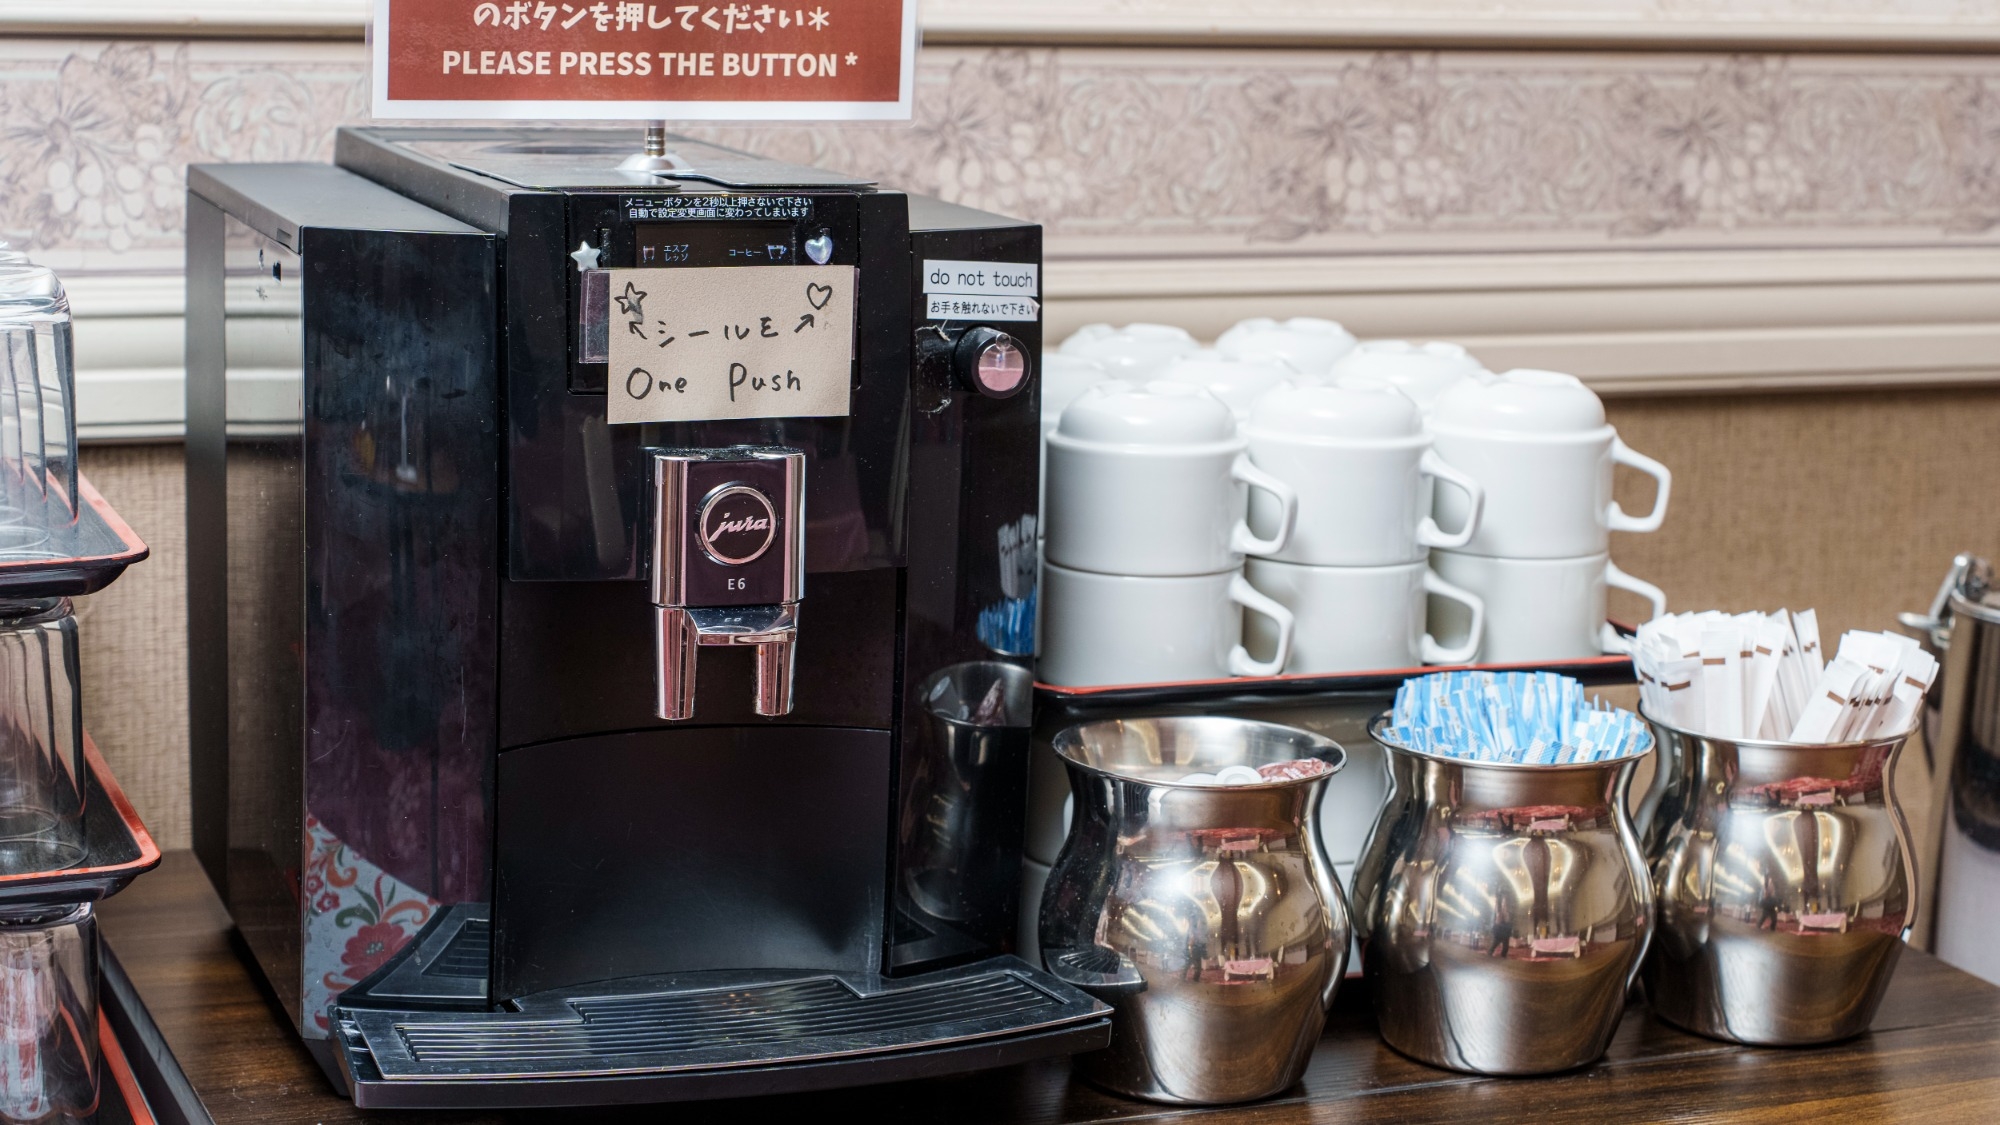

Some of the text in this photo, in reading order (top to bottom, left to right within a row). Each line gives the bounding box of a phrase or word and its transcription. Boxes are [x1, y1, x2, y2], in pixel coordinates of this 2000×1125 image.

[442, 51, 552, 75] PLEASE
[559, 52, 652, 75] PRESS
[659, 52, 714, 76] THE
[722, 52, 837, 77] BUTTON
[625, 197, 812, 208] メニューボタンを2秒以上押さないで下さい
[629, 207, 808, 218] 自動で設定変更画面に変わってしまいます
[930, 269, 1032, 287] do not touch
[931, 301, 1034, 315] お手を触れないで下さい
[626, 363, 801, 402] One Push
[708, 512, 769, 543] jura
